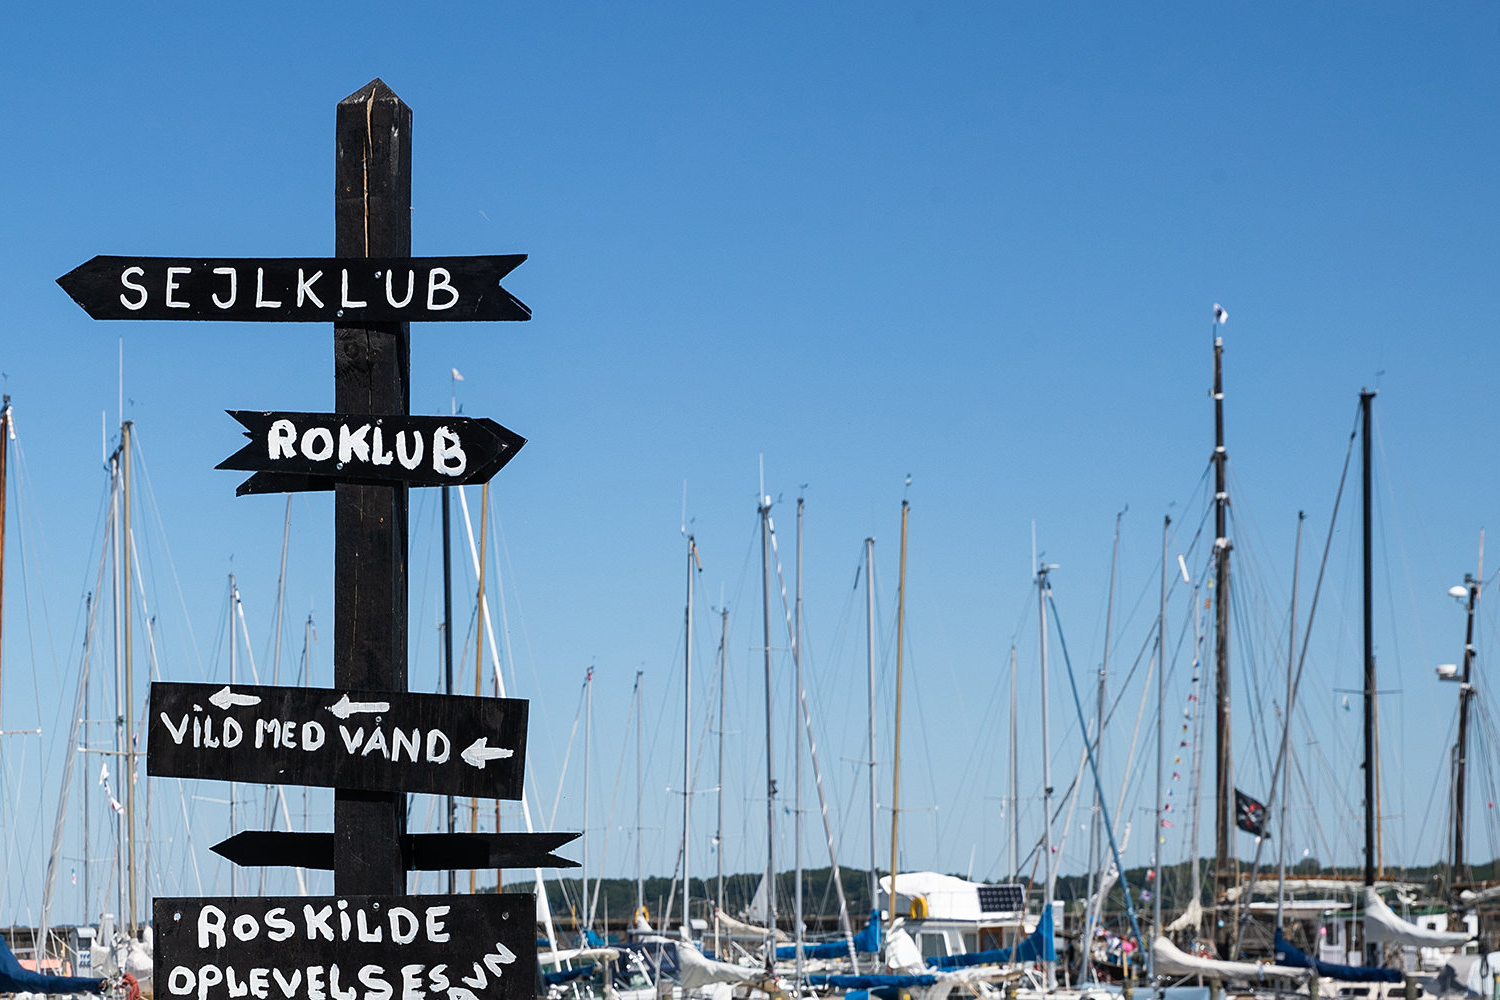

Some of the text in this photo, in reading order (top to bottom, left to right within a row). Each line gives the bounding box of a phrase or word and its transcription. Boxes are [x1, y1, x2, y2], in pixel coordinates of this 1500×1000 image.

[119, 266, 460, 311] SEJLKLUB
[267, 419, 467, 477] ROKLUB
[254, 717, 326, 752] MED
